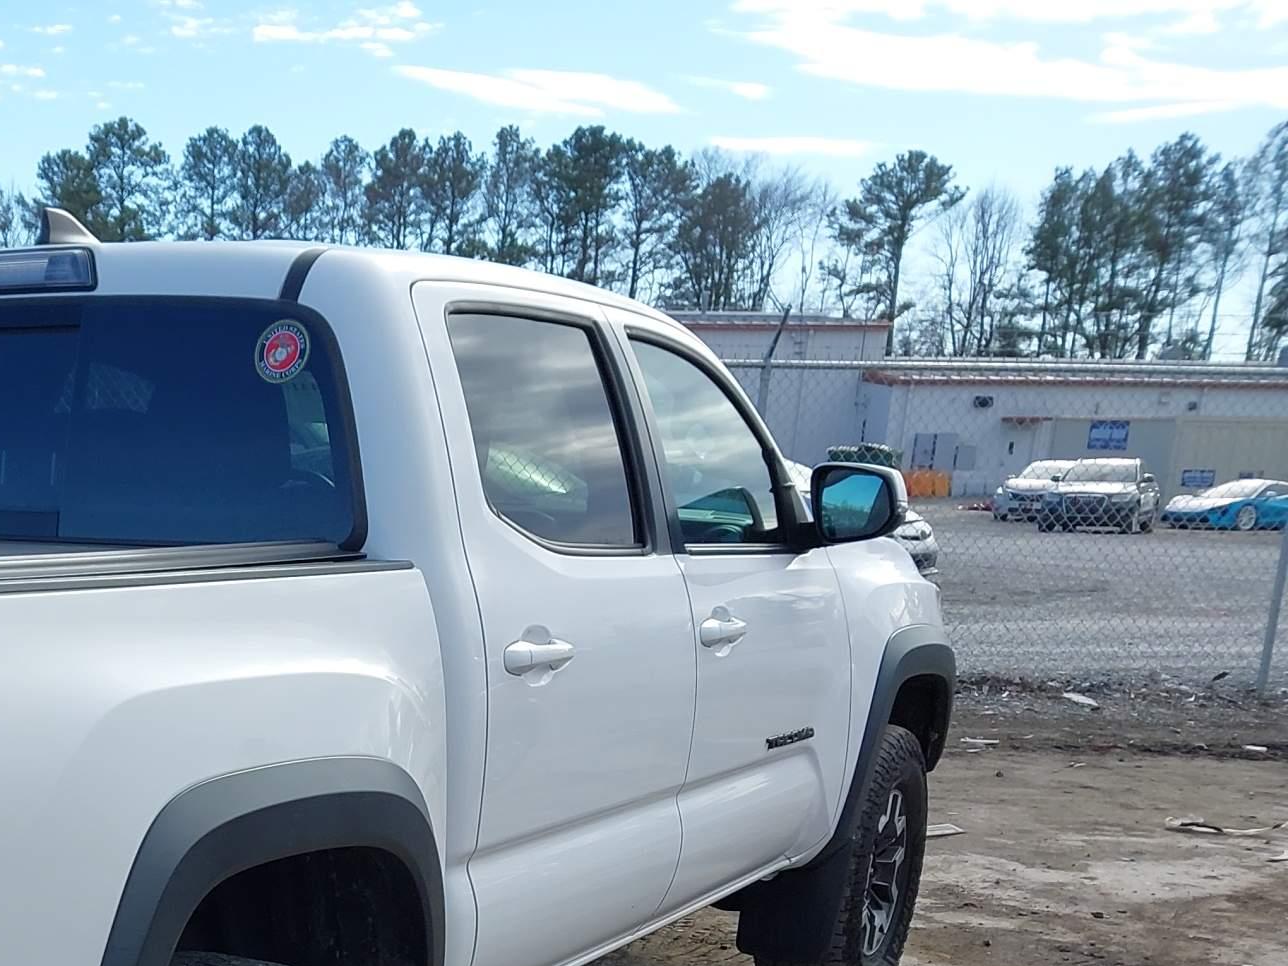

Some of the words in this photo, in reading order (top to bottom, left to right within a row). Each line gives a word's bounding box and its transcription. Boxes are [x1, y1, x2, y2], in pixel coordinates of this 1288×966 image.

[263, 325, 289, 344] UNITED
[289, 326, 305, 349] STATES
[259, 360, 281, 378] MARINE
[281, 359, 303, 378] CORPS
